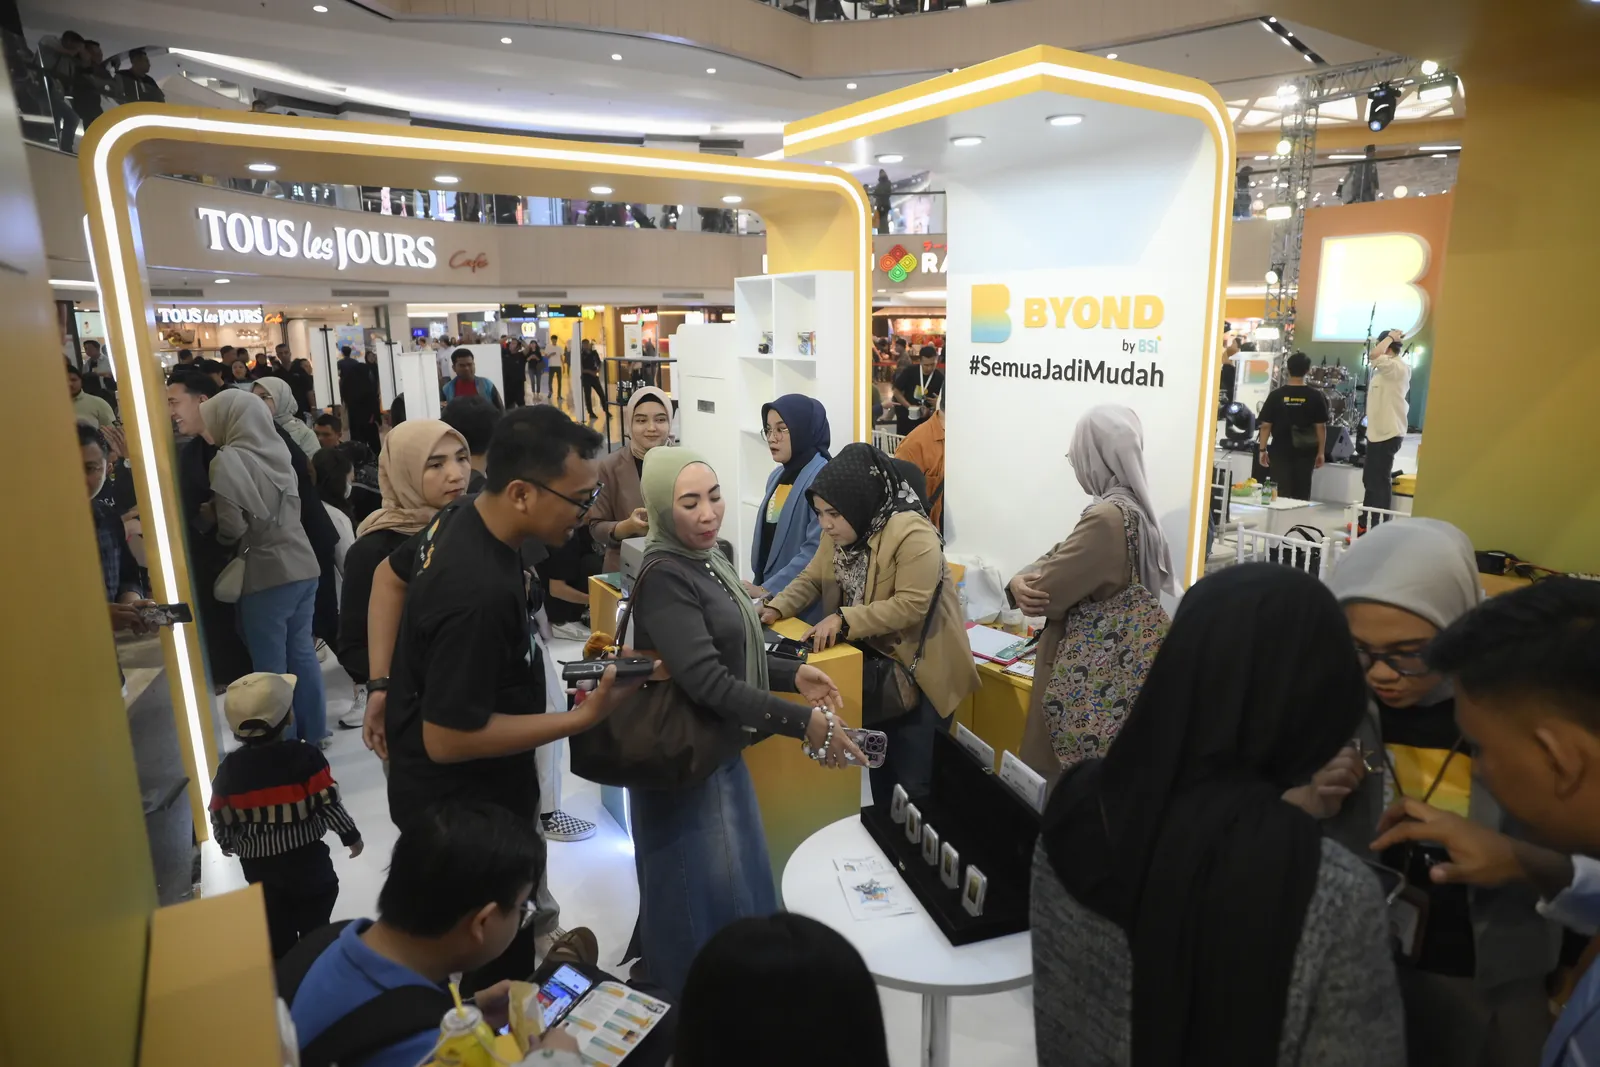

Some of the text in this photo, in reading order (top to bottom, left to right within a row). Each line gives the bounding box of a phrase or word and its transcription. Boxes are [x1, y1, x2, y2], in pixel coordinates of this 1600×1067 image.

[198, 207, 298, 258] TOUS
[302, 221, 333, 260] les
[334, 226, 437, 270] JOURS
[158, 307, 202, 323] TOUS
[218, 307, 263, 326] JOURS
[971, 284, 1012, 343] B
[1024, 295, 1164, 329] BYOND
[1122, 336, 1162, 354] by BSI
[969, 355, 1164, 387] #SemuaJadiMudah
